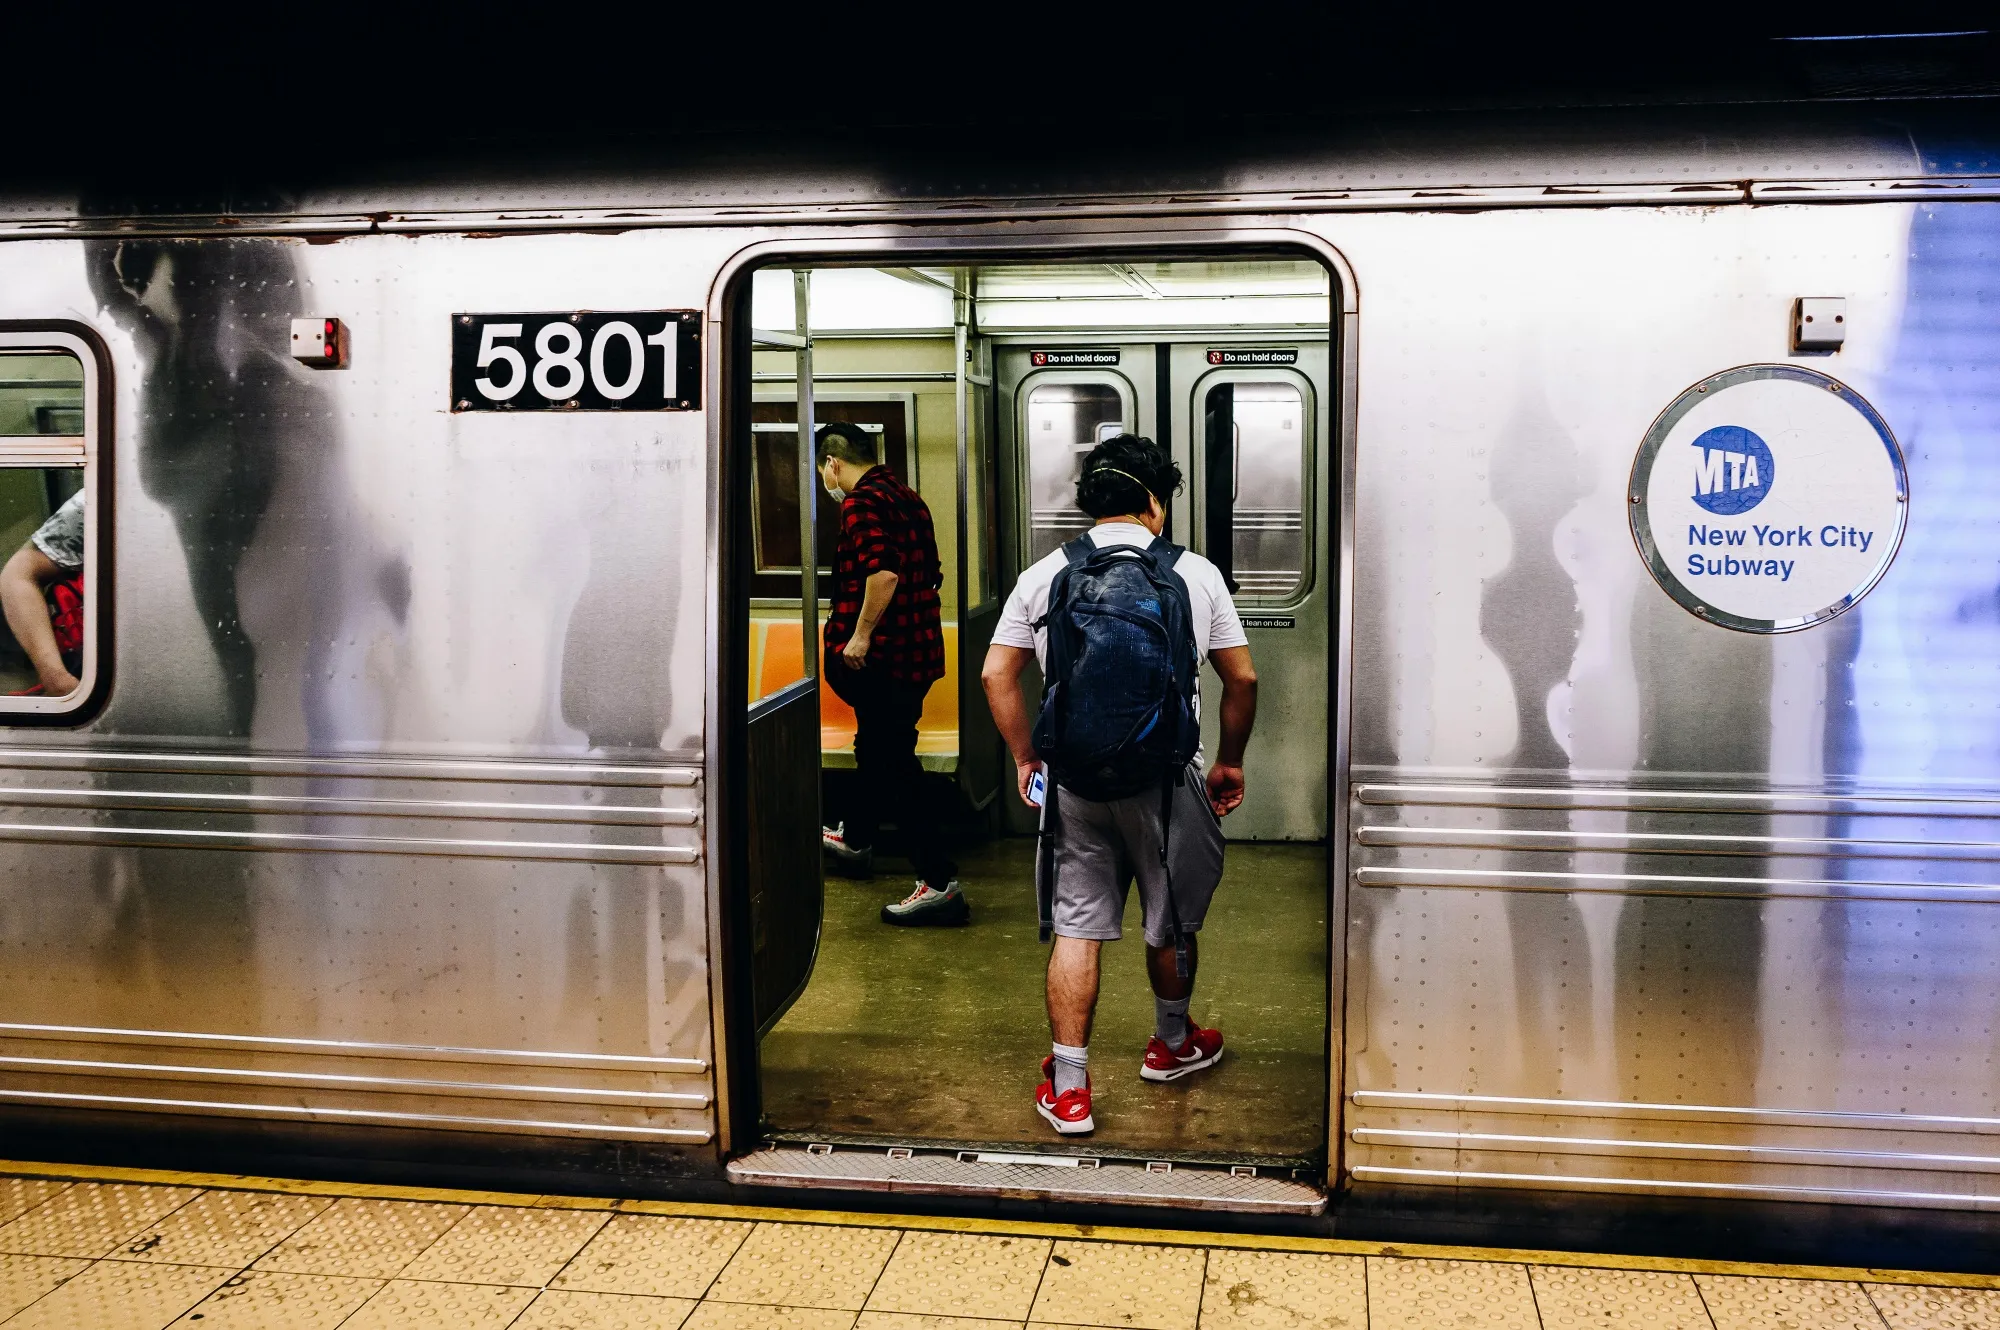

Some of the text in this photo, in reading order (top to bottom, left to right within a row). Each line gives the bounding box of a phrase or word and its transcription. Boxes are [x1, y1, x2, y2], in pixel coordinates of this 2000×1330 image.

[474, 321, 678, 400] 5801
[1047, 354, 1117, 363] Do not hold doors
[1224, 353, 1295, 362] Do not hold doors
[1690, 447, 1760, 498] MTA
[1688, 524, 1874, 553] New York City
[1687, 553, 1795, 582] Subway
[1246, 619, 1262, 627] lean
[1273, 619, 1291, 627] door
